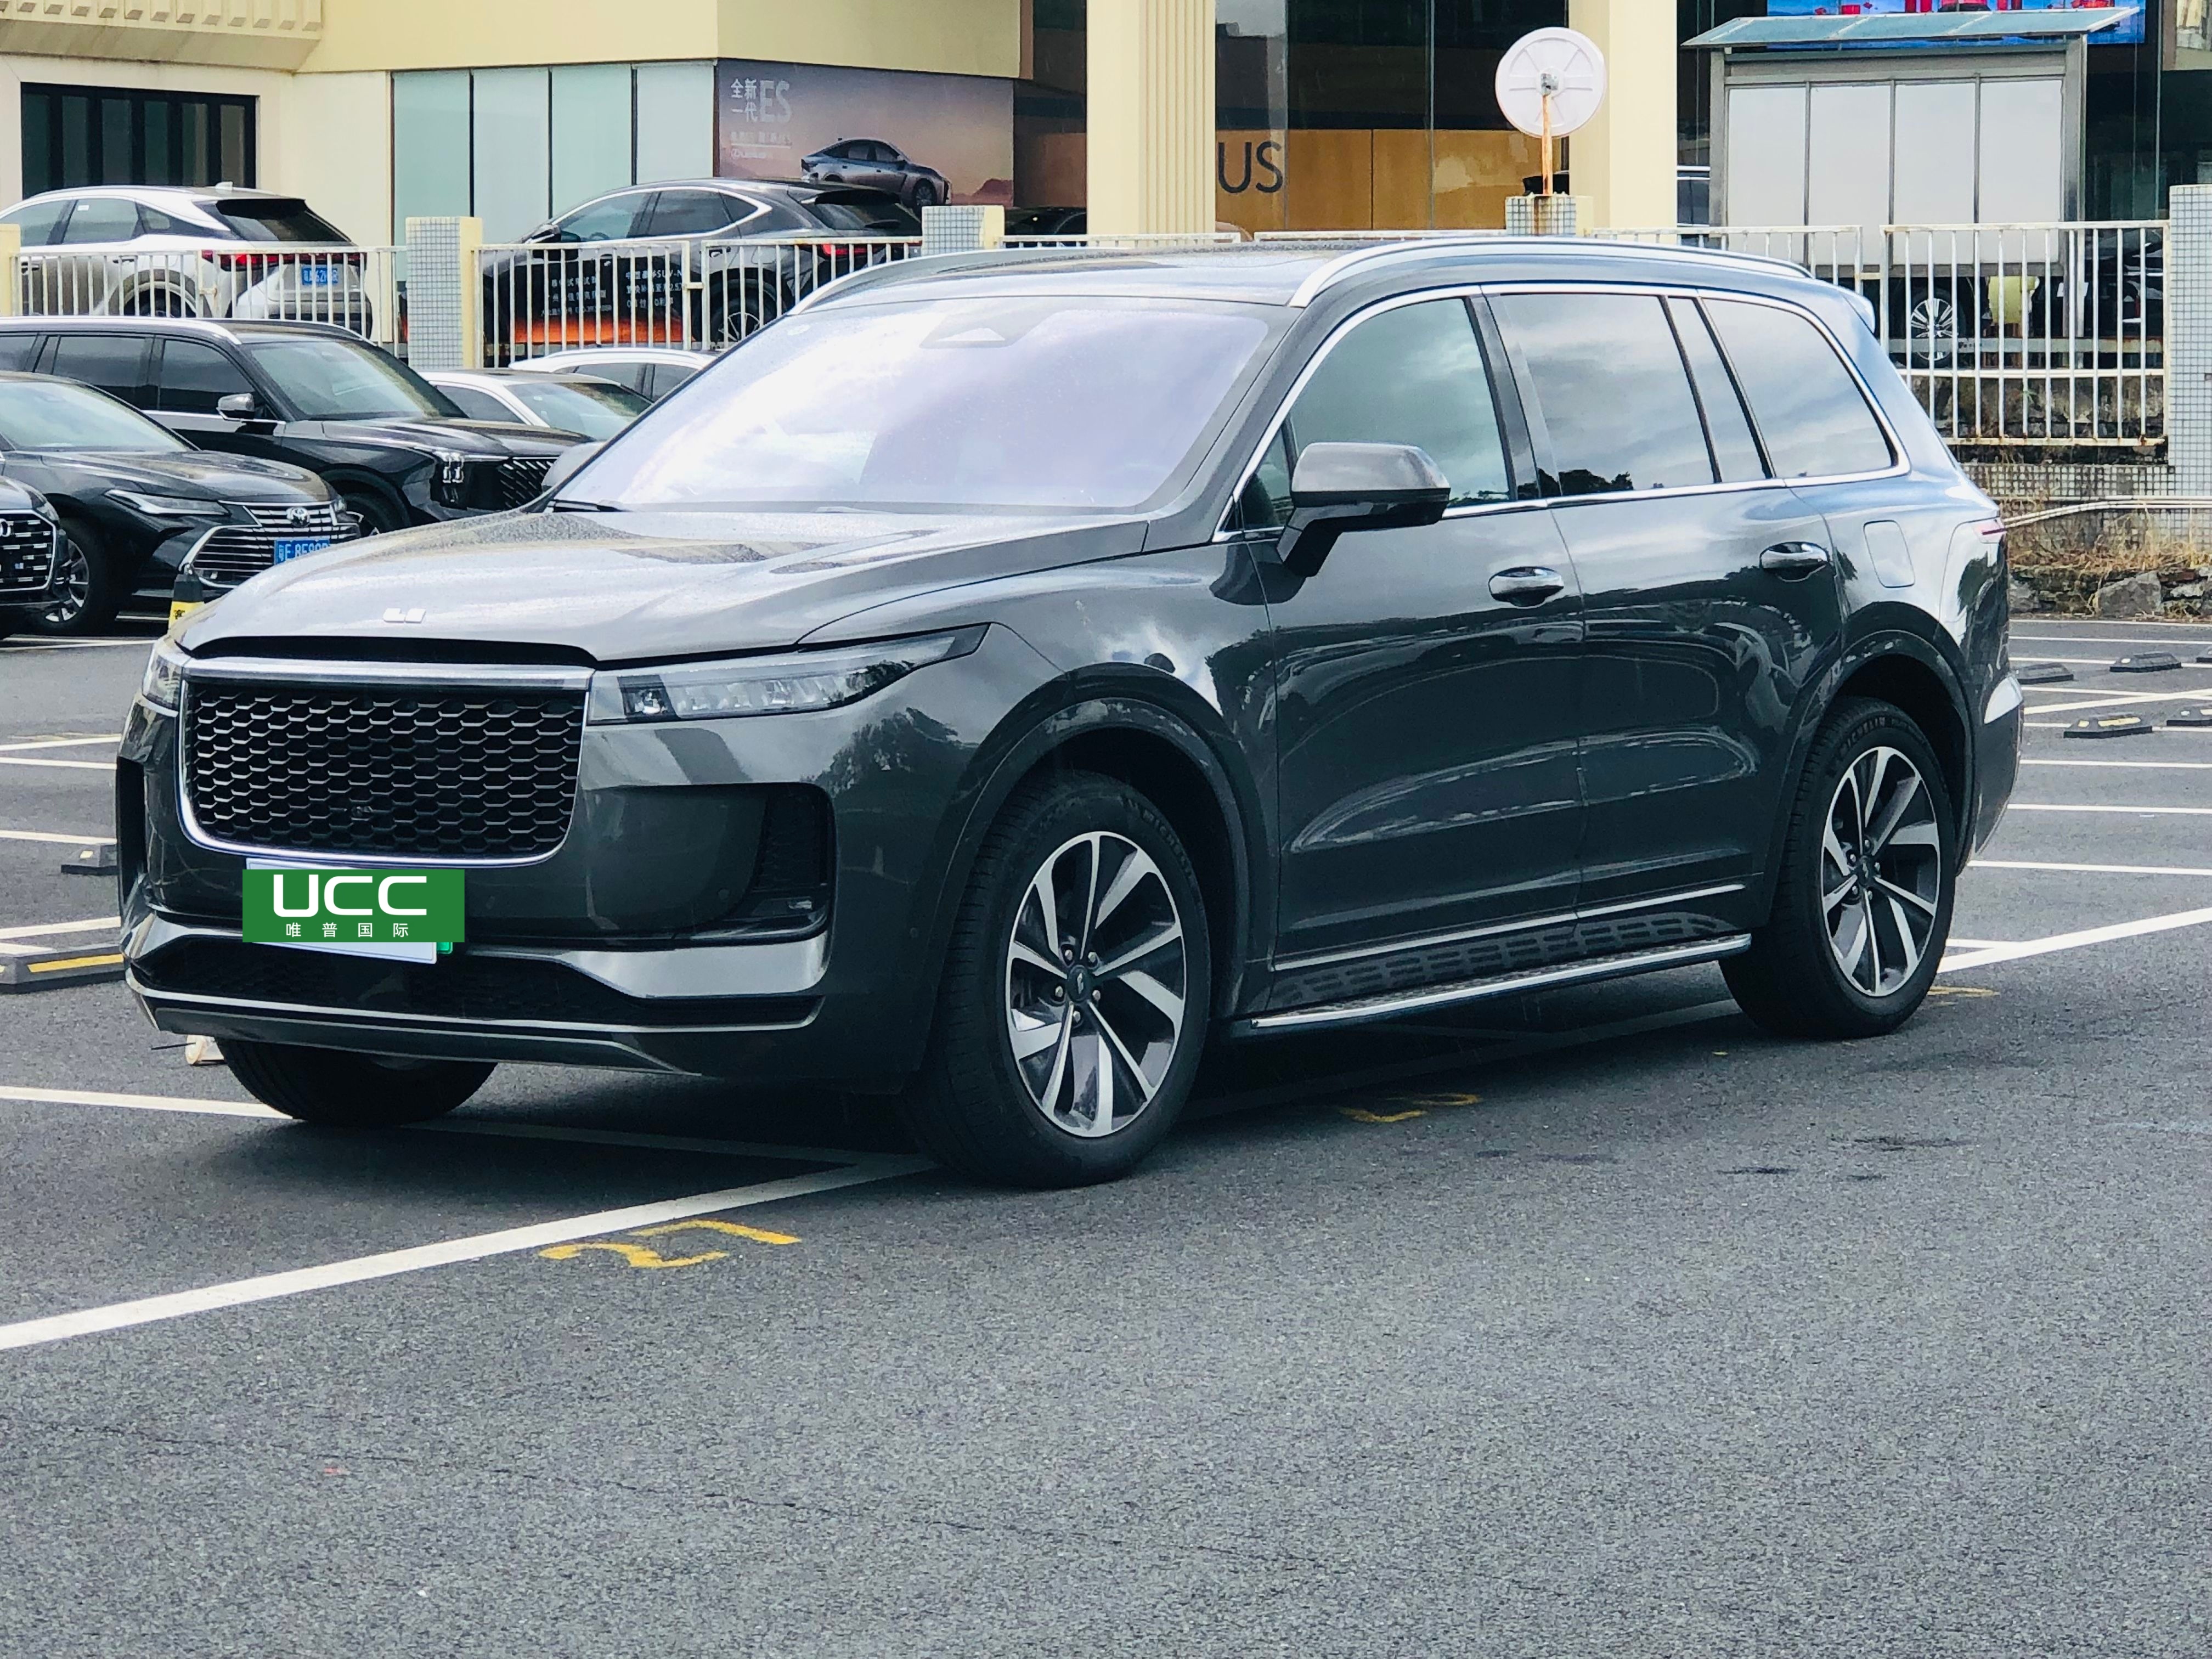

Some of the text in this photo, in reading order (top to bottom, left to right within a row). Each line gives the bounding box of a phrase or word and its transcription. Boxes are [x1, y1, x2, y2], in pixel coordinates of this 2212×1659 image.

[730, 78, 757, 100] 全新
[731, 101, 758, 122] 一代
[759, 79, 791, 122] ES
